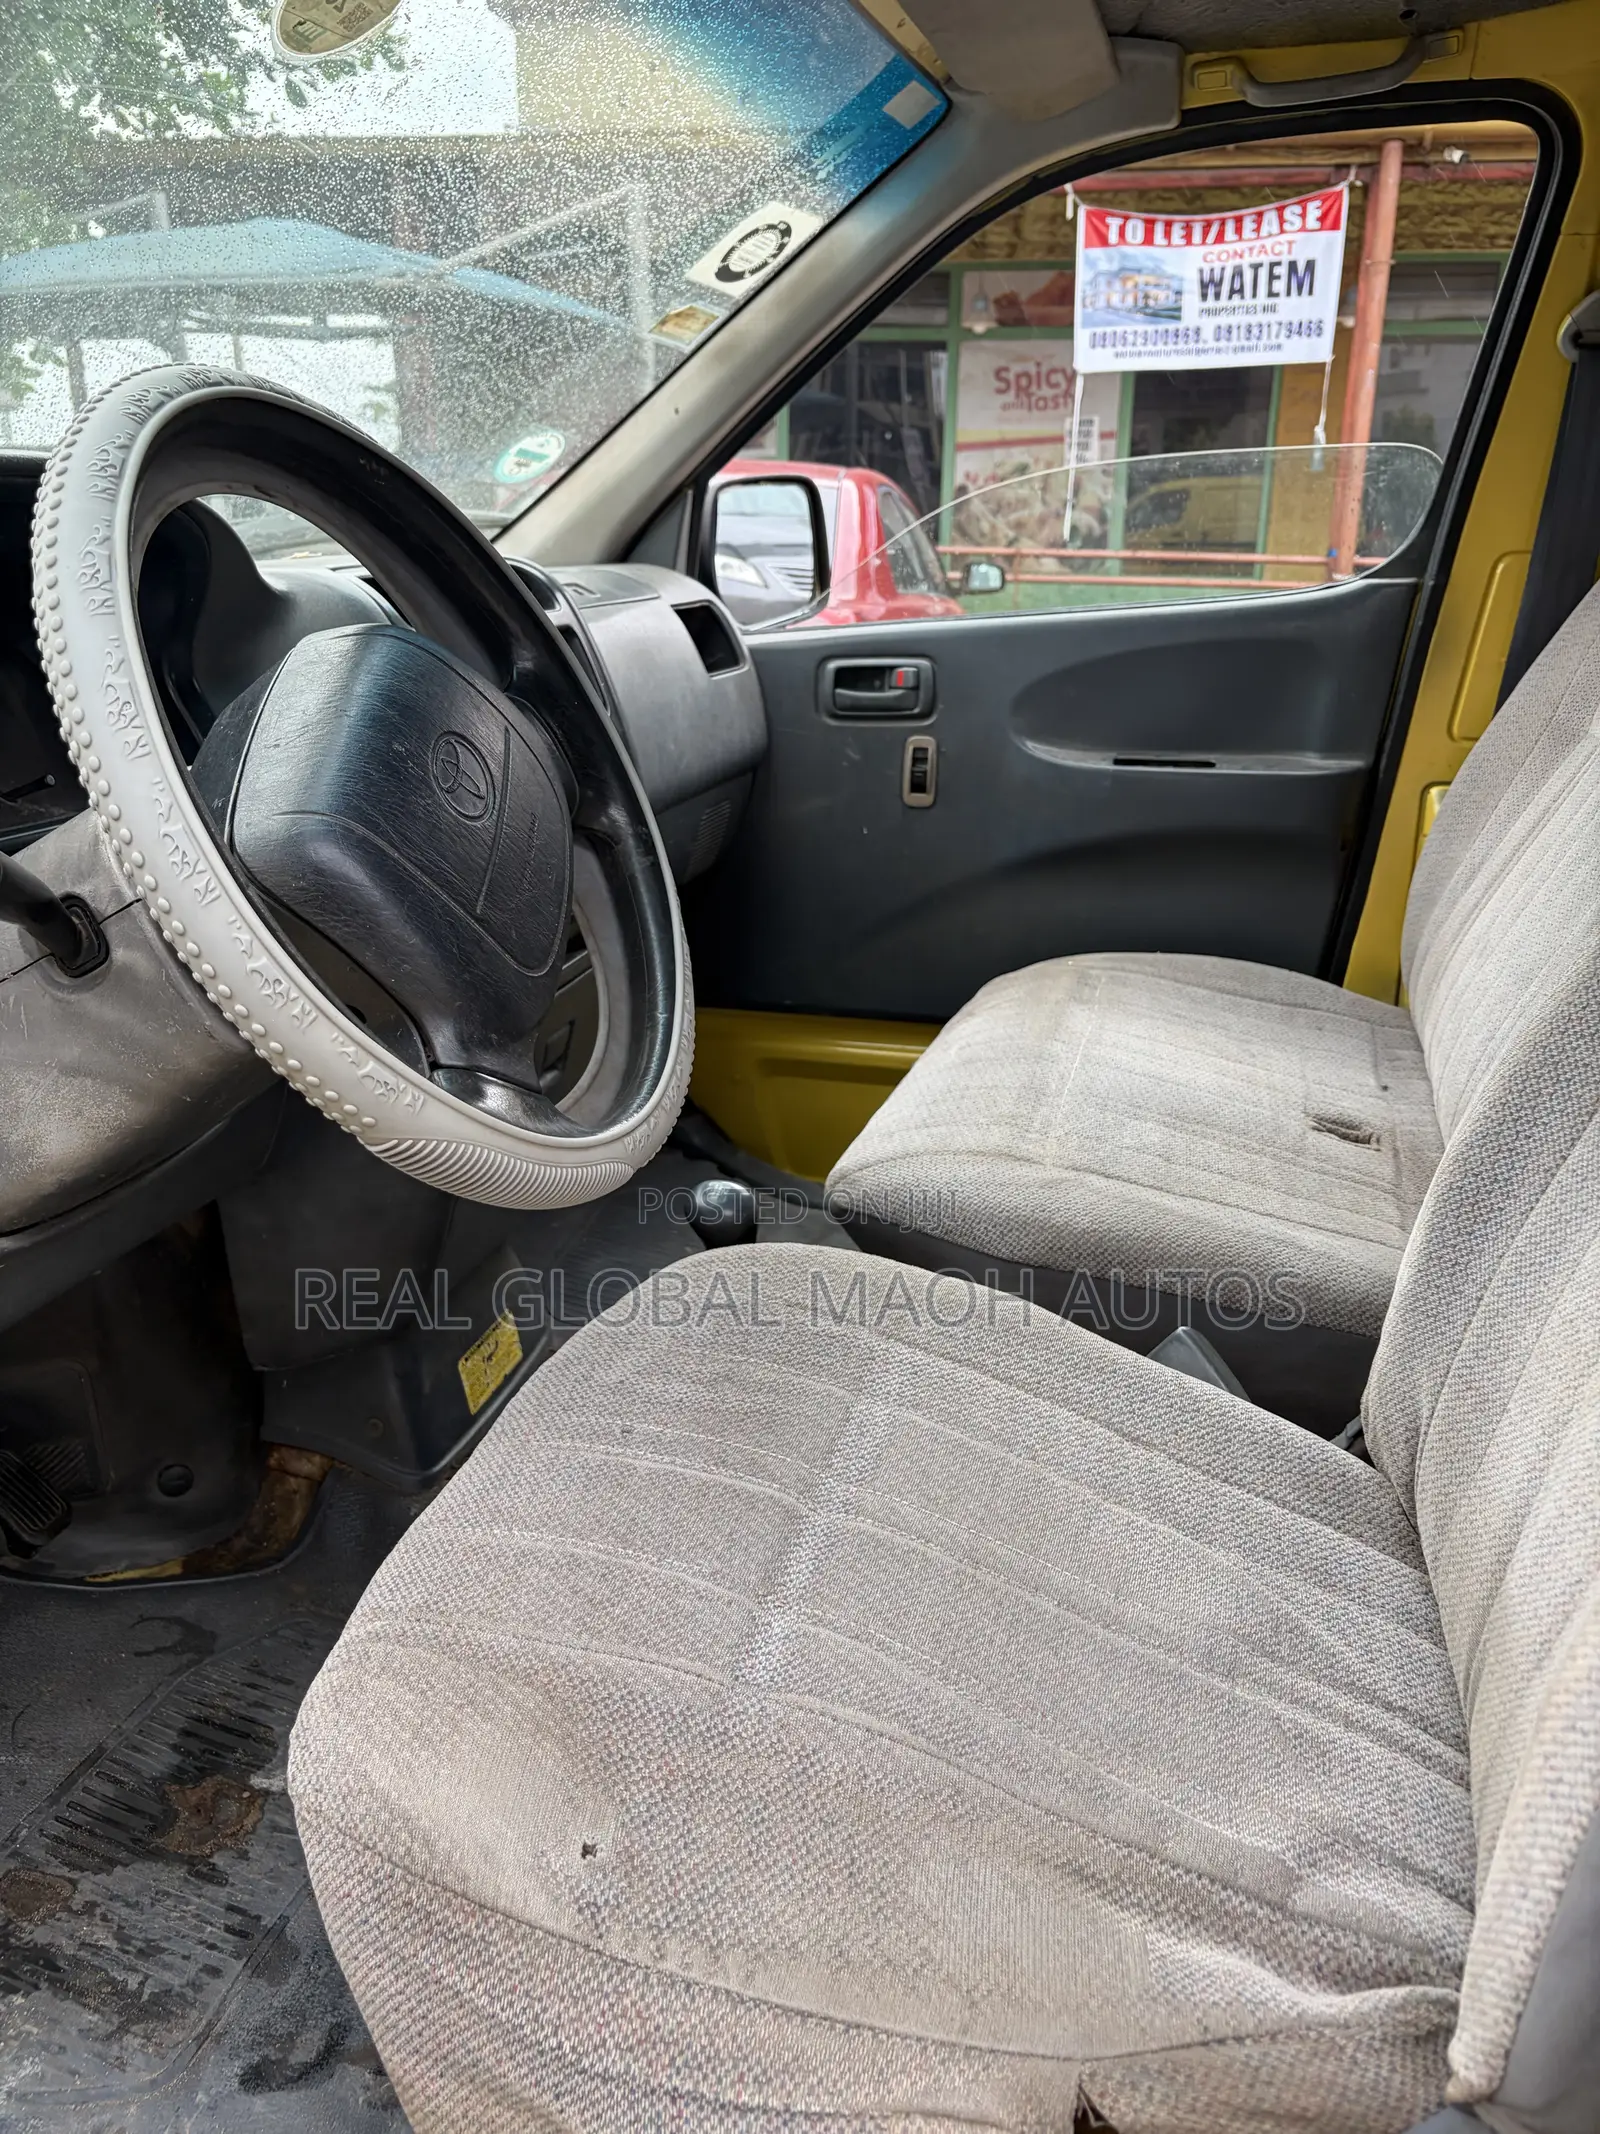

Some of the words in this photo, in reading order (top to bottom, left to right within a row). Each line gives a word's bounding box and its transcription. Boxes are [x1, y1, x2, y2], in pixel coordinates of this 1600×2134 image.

[1105, 216, 1145, 245] TO
[1153, 200, 1322, 247] LET/LEASE
[1202, 240, 1296, 263] CONTACT
[1198, 259, 1316, 302] WATEM
[994, 361, 1077, 399] Spicy
